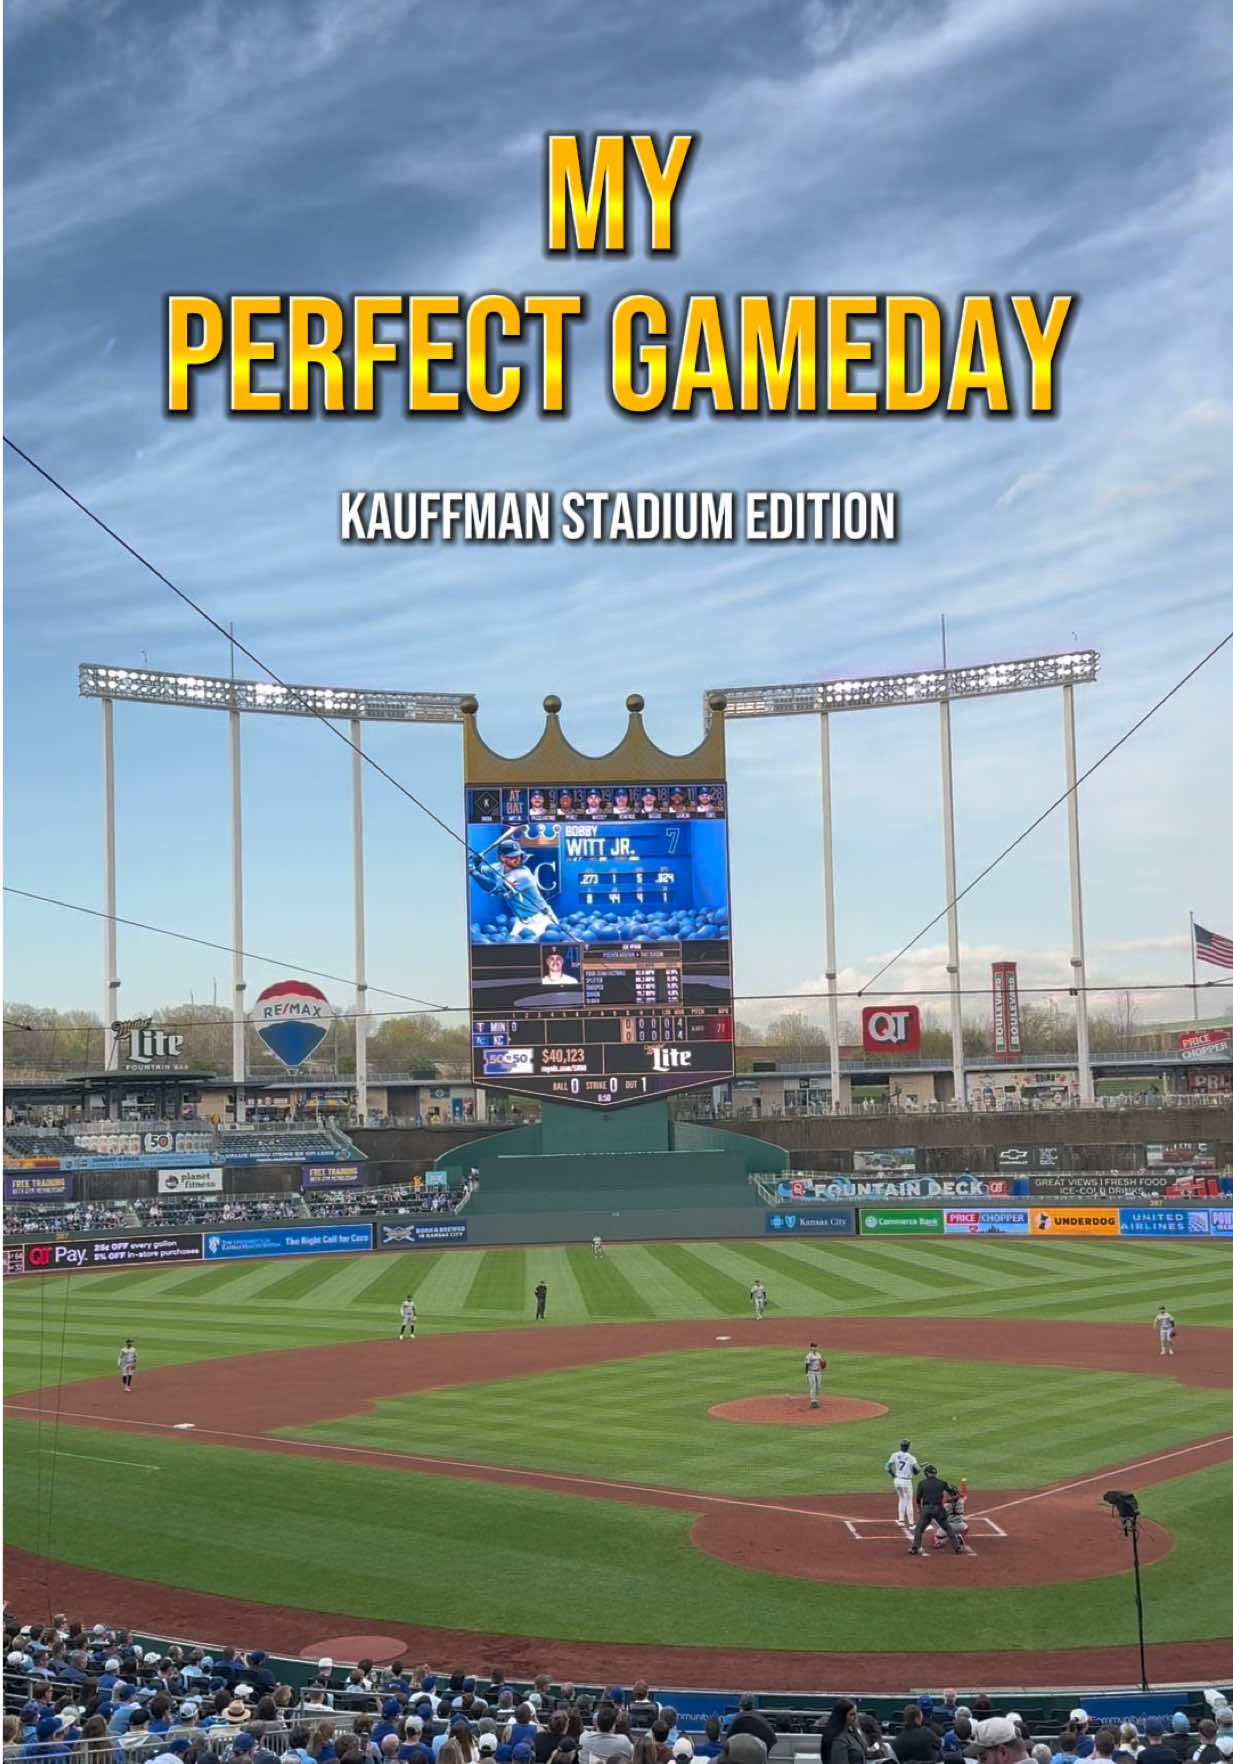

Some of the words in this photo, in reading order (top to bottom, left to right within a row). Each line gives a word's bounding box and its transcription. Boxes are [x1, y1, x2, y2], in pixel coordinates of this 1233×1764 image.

[510, 789, 520, 801] AT
[506, 802, 524, 814] BAT
[565, 825, 597, 837] BOBBY
[566, 838, 605, 856] WITT
[610, 838, 635, 856] JR.
[666, 828, 680, 854] 7
[534, 861, 557, 891] C
[264, 1002, 321, 1018] RE/MAX
[490, 1022, 505, 1031] MIN
[511, 1022, 517, 1032] 0
[868, 1011, 911, 1044] QT
[127, 1029, 184, 1064] Lite
[1182, 1034, 1209, 1049] PRICE
[542, 1048, 585, 1064] $40,123
[1182, 1042, 1228, 1060] CHOPPER
[652, 1047, 692, 1072] Lite
[553, 1081, 568, 1091] BALL
[571, 1078, 579, 1093] 0
[585, 1081, 608, 1090] STRIKE
[609, 1077, 617, 1093] 0
[625, 1080, 637, 1089] OUT
[641, 1077, 647, 1093] 1
[181, 1172, 210, 1182] planet
[1035, 1178, 1063, 1186] GREAT
[1067, 1178, 1098, 1186] VIEWS
[1105, 1177, 1137, 1186] FRESH
[1139, 1177, 1167, 1186] FOOD
[184, 1180, 216, 1189] fitness
[814, 1182, 920, 1197] FOUNTAIN
[928, 1181, 984, 1196] DECK
[800, 1216, 829, 1225] Kansas
[831, 1216, 846, 1225] City
[879, 1217, 917, 1226] Commerce
[919, 1216, 938, 1226] Bank
[949, 1213, 977, 1222] PRICE
[981, 1213, 1024, 1222] CHOPPER
[1054, 1216, 1115, 1226] UNDERDOG
[1132, 1213, 1184, 1221] UNITED
[1120, 1222, 1184, 1230] AIRLINES
[111, 1242, 129, 1251] OFF
[130, 1242, 152, 1250] every
[153, 1239, 177, 1249] gallon
[285, 1237, 299, 1246] The
[301, 1236, 321, 1246] Right
[323, 1234, 337, 1244] Call
[339, 1234, 350, 1243] for
[351, 1233, 368, 1243] Care
[55, 1246, 88, 1265] Pay.
[108, 1251, 126, 1260] OFF
[127, 1250, 159, 1259] in-store
[160, 1248, 200, 1257] purchases
[899, 1461, 906, 1471] 7
